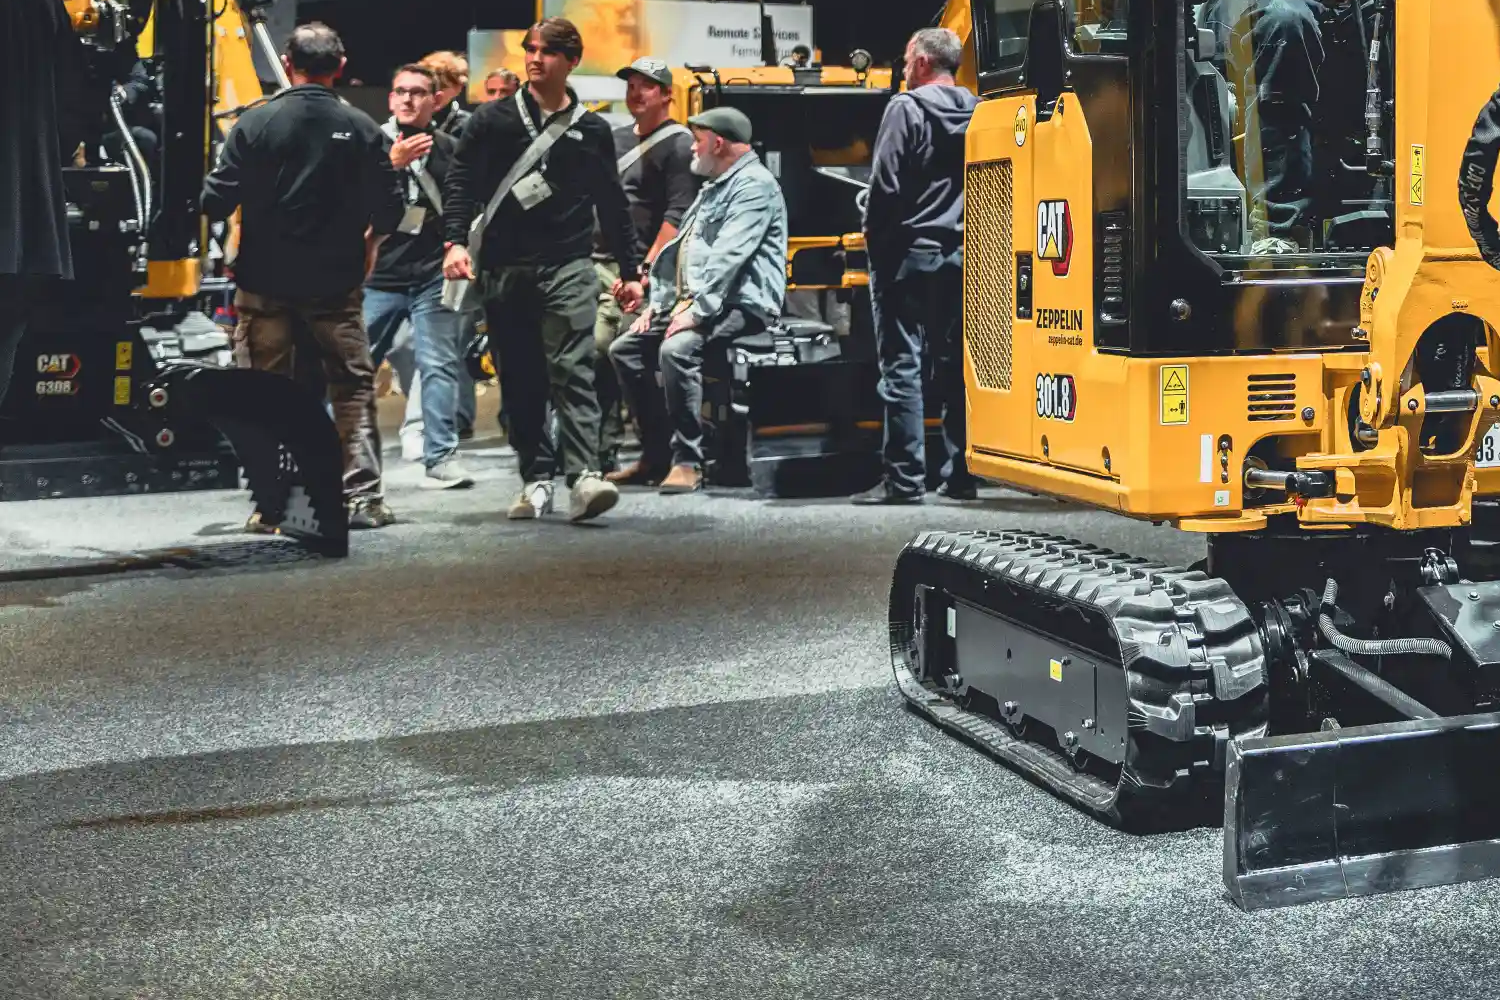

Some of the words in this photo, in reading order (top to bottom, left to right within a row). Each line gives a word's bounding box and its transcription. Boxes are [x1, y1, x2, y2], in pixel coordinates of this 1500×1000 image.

[708, 25, 750, 40] Remote
[753, 28, 800, 41] Svices
[1015, 118, 1026, 132] HVO
[1037, 201, 1065, 258] CAT
[1036, 308, 1083, 331] ZEPPELIN
[1048, 333, 1083, 347] zeppelin-cat.de
[37, 353, 71, 372] CAT
[1036, 375, 1070, 418] 301.8
